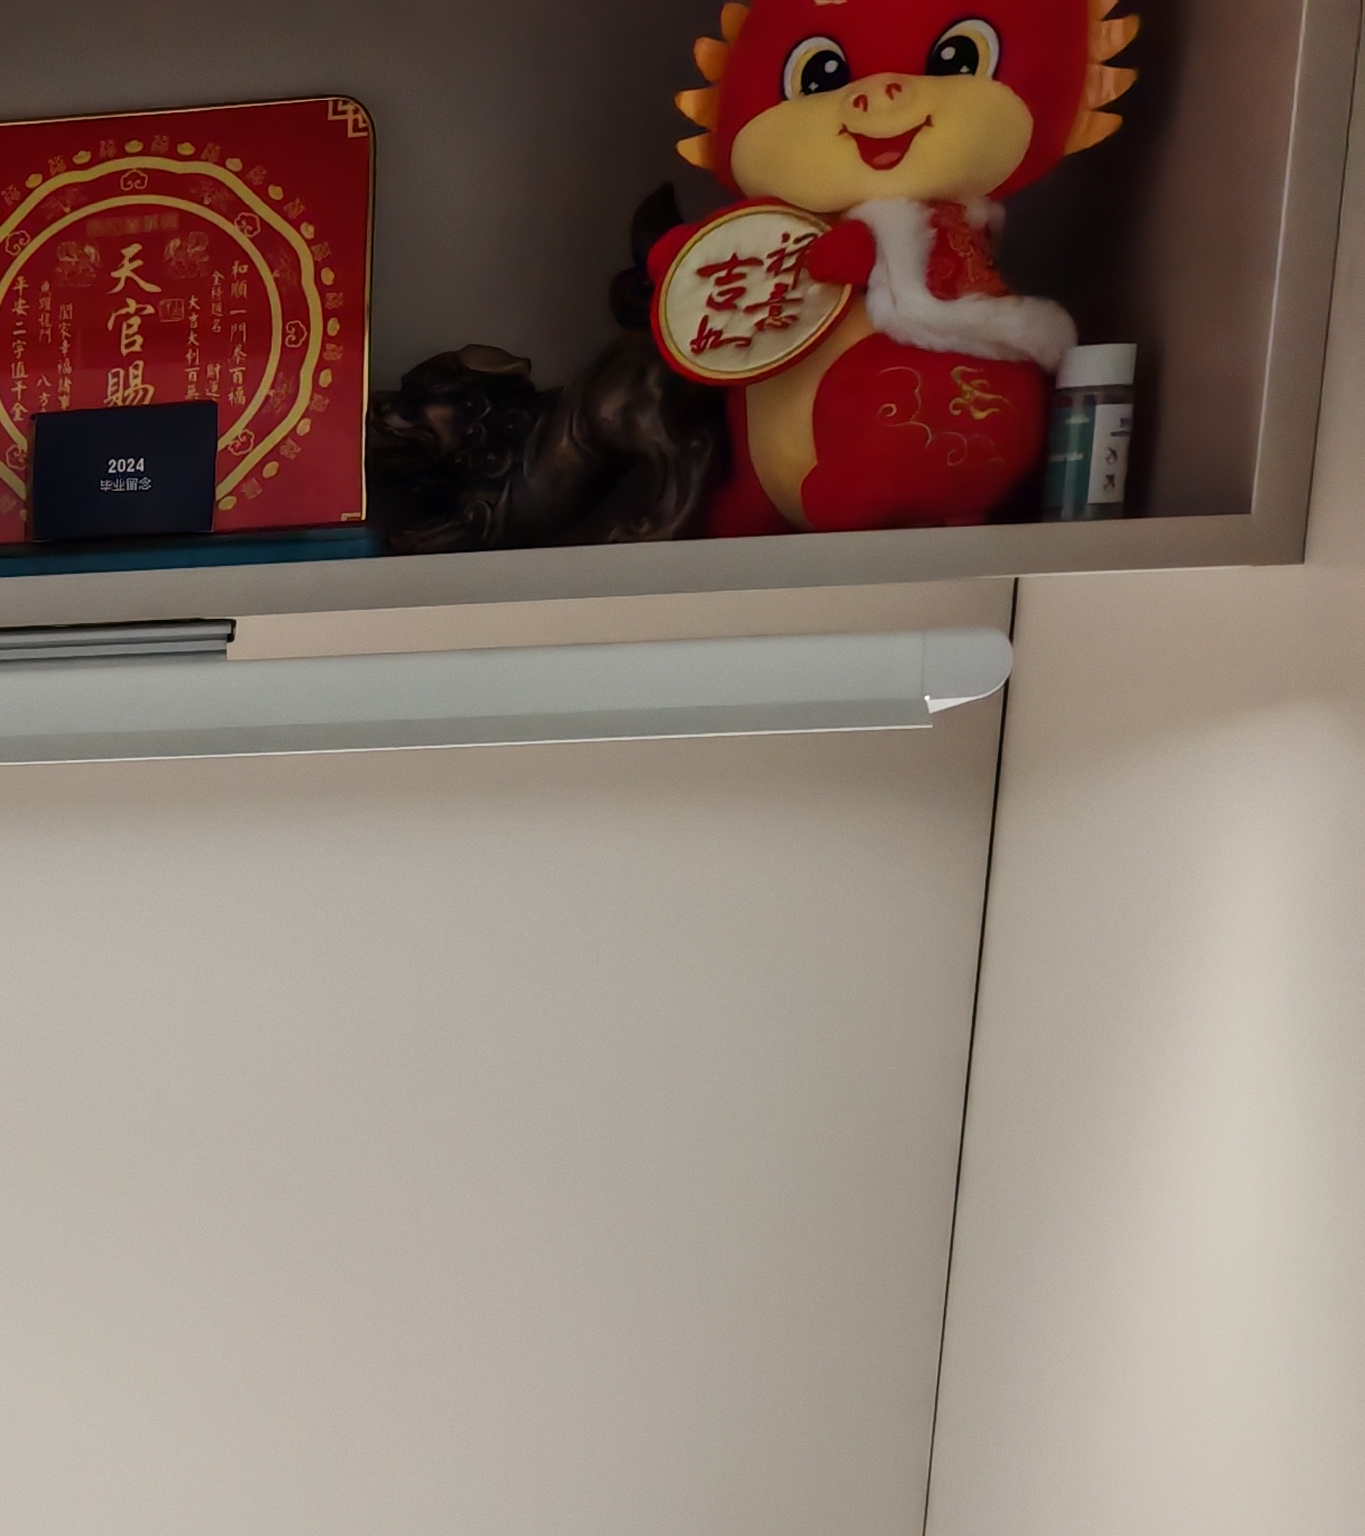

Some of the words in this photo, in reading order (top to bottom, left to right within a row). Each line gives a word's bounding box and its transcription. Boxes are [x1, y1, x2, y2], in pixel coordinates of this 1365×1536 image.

[108, 457, 145, 474] 2024
[100, 476, 152, 492] 毕业留念
